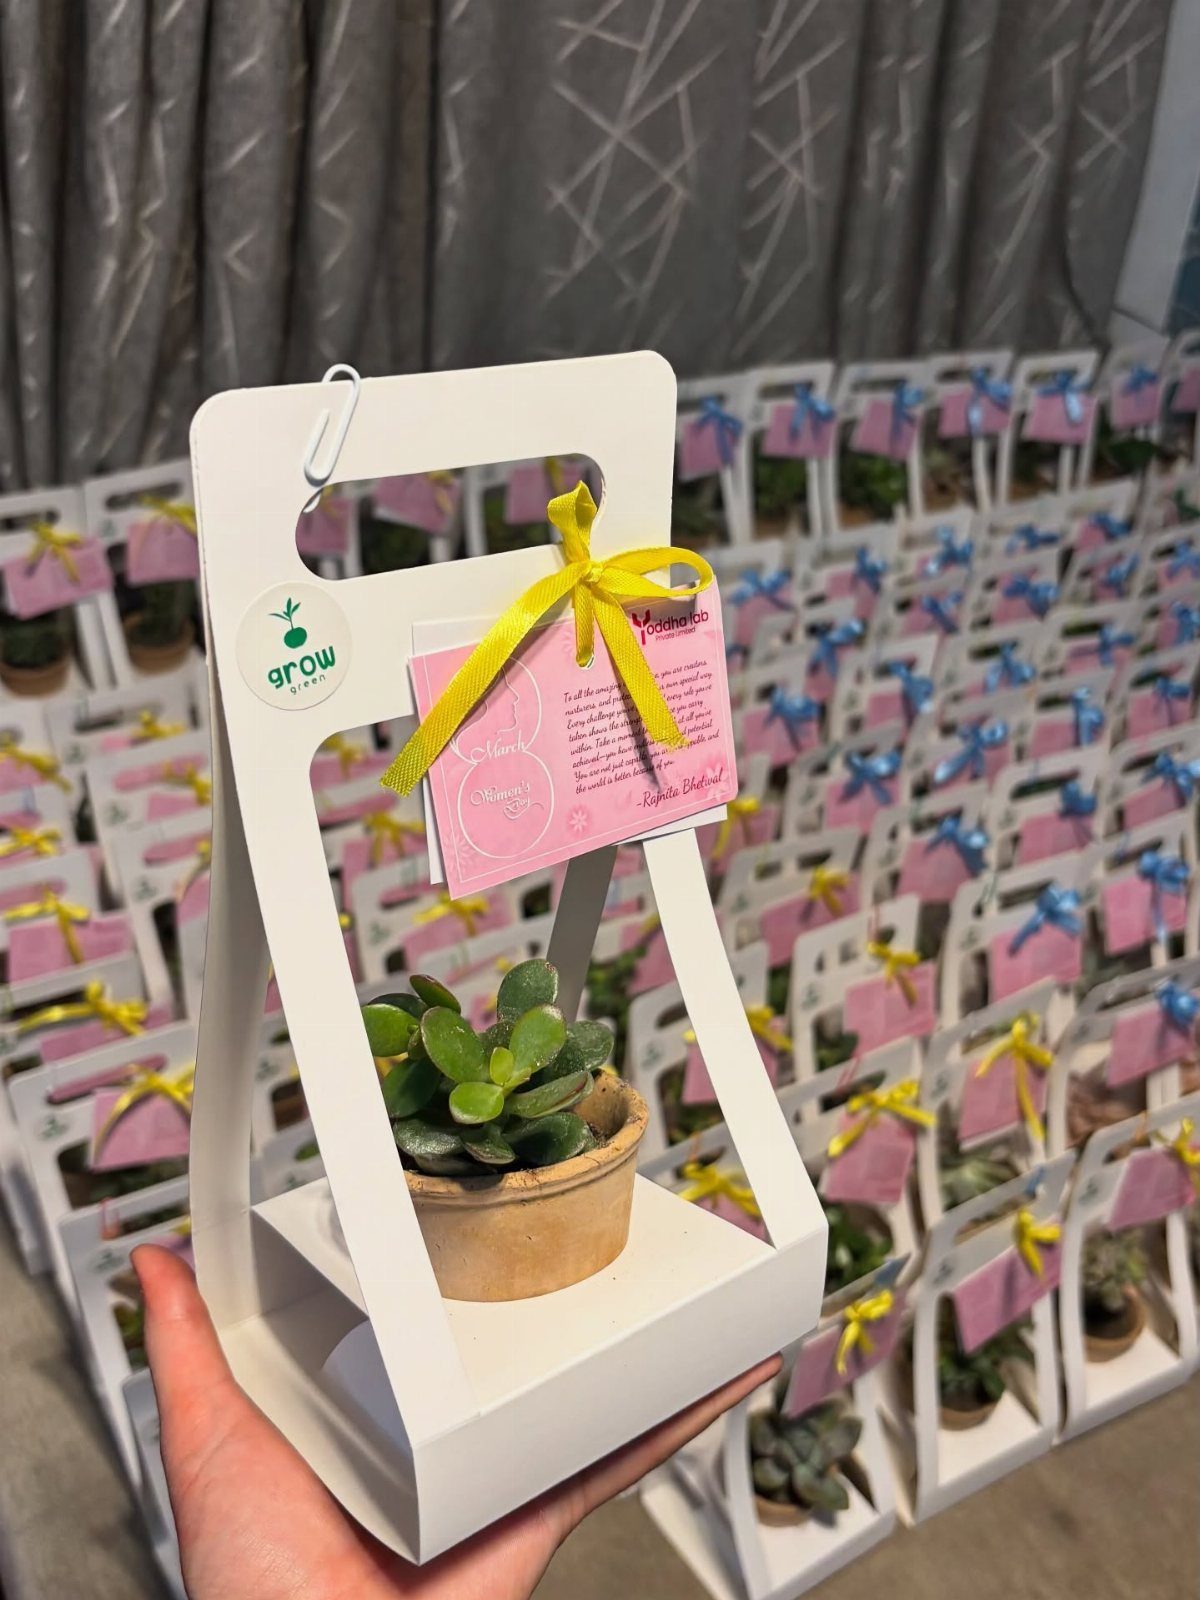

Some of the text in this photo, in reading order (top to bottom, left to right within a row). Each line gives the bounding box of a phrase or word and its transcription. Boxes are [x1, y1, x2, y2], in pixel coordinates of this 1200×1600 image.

[655, 626, 696, 641] Private Limited
[690, 609, 709, 625] lab
[267, 645, 336, 690] grow
[290, 674, 326, 696] green
[573, 688, 583, 700] all
[584, 686, 594, 698] the
[660, 670, 672, 680] you
[598, 694, 611, 706] and
[680, 671, 699, 687] special
[567, 718, 586, 730] Every
[586, 711, 616, 724] challenge
[667, 694, 682, 702] every
[684, 685, 694, 696] role
[569, 730, 588, 742] taken
[588, 726, 608, 738] shows
[608, 720, 620, 731] the
[676, 704, 687, 714] you
[688, 700, 704, 708] carry
[470, 729, 527, 764] March
[596, 736, 610, 748] Take
[678, 714, 684, 724] at
[686, 711, 695, 722] all
[574, 770, 588, 783] You
[589, 768, 600, 777] are
[600, 763, 611, 773] not
[611, 759, 624, 772] just
[707, 728, 720, 741] and
[618, 745, 632, 755] have
[470, 779, 531, 806] Women's
[576, 784, 586, 794] the
[588, 776, 606, 791] world
[608, 777, 613, 785] is
[614, 772, 632, 783] better
[656, 759, 663, 771] of
